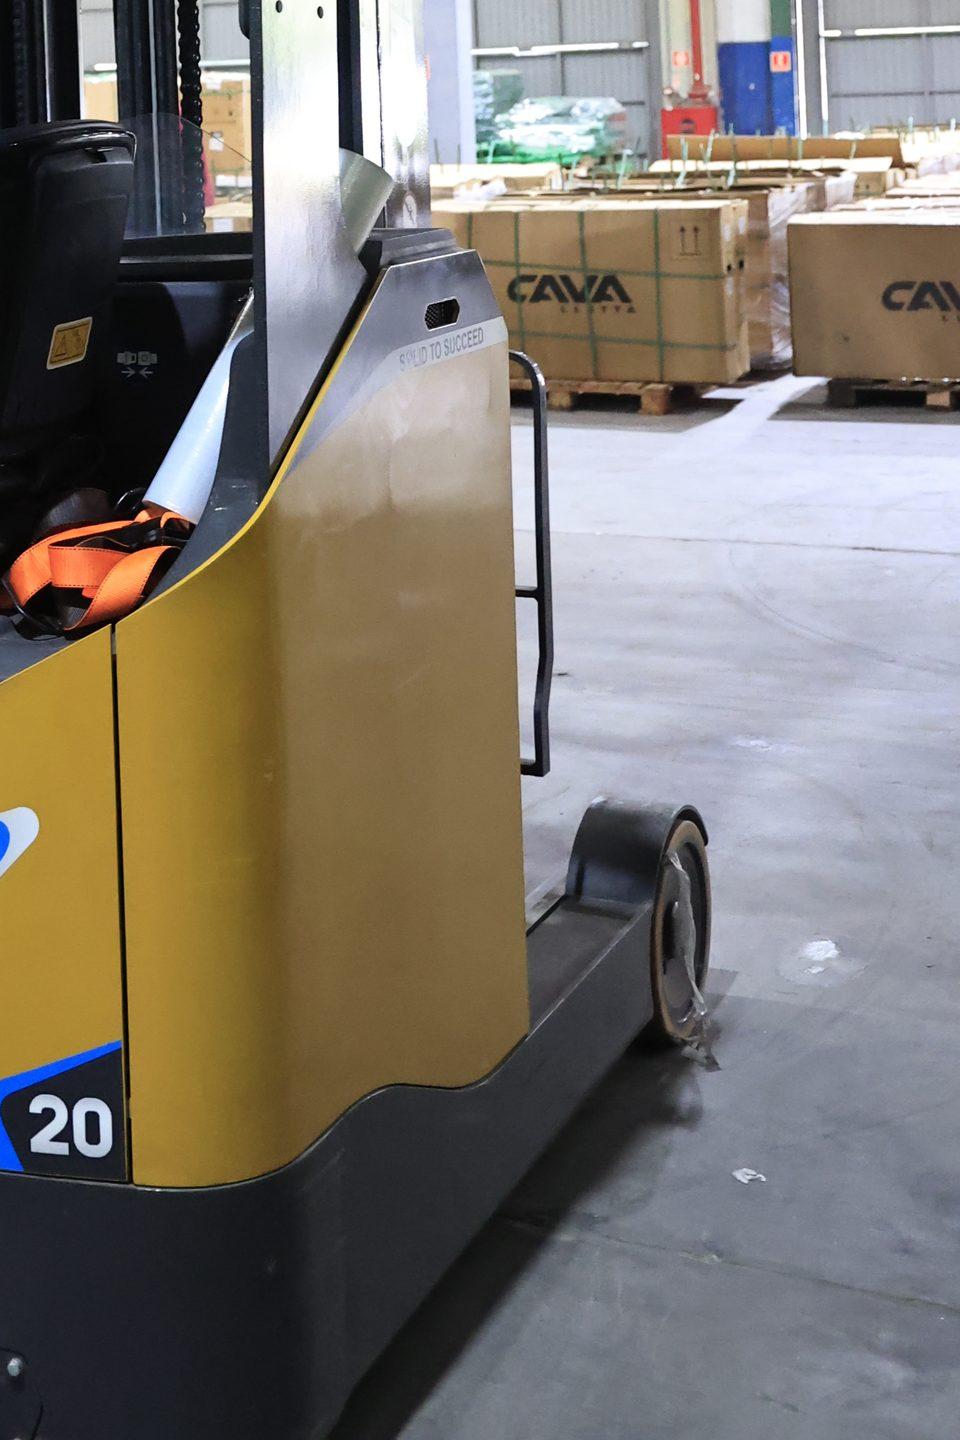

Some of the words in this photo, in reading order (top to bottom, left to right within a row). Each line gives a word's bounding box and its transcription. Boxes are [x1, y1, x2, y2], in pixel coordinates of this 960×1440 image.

[507, 274, 632, 303] CAVA
[882, 281, 960, 312] CA
[429, 341, 441, 360] TO
[443, 327, 484, 357] SUCCEED
[29, 1094, 113, 1158] 20
